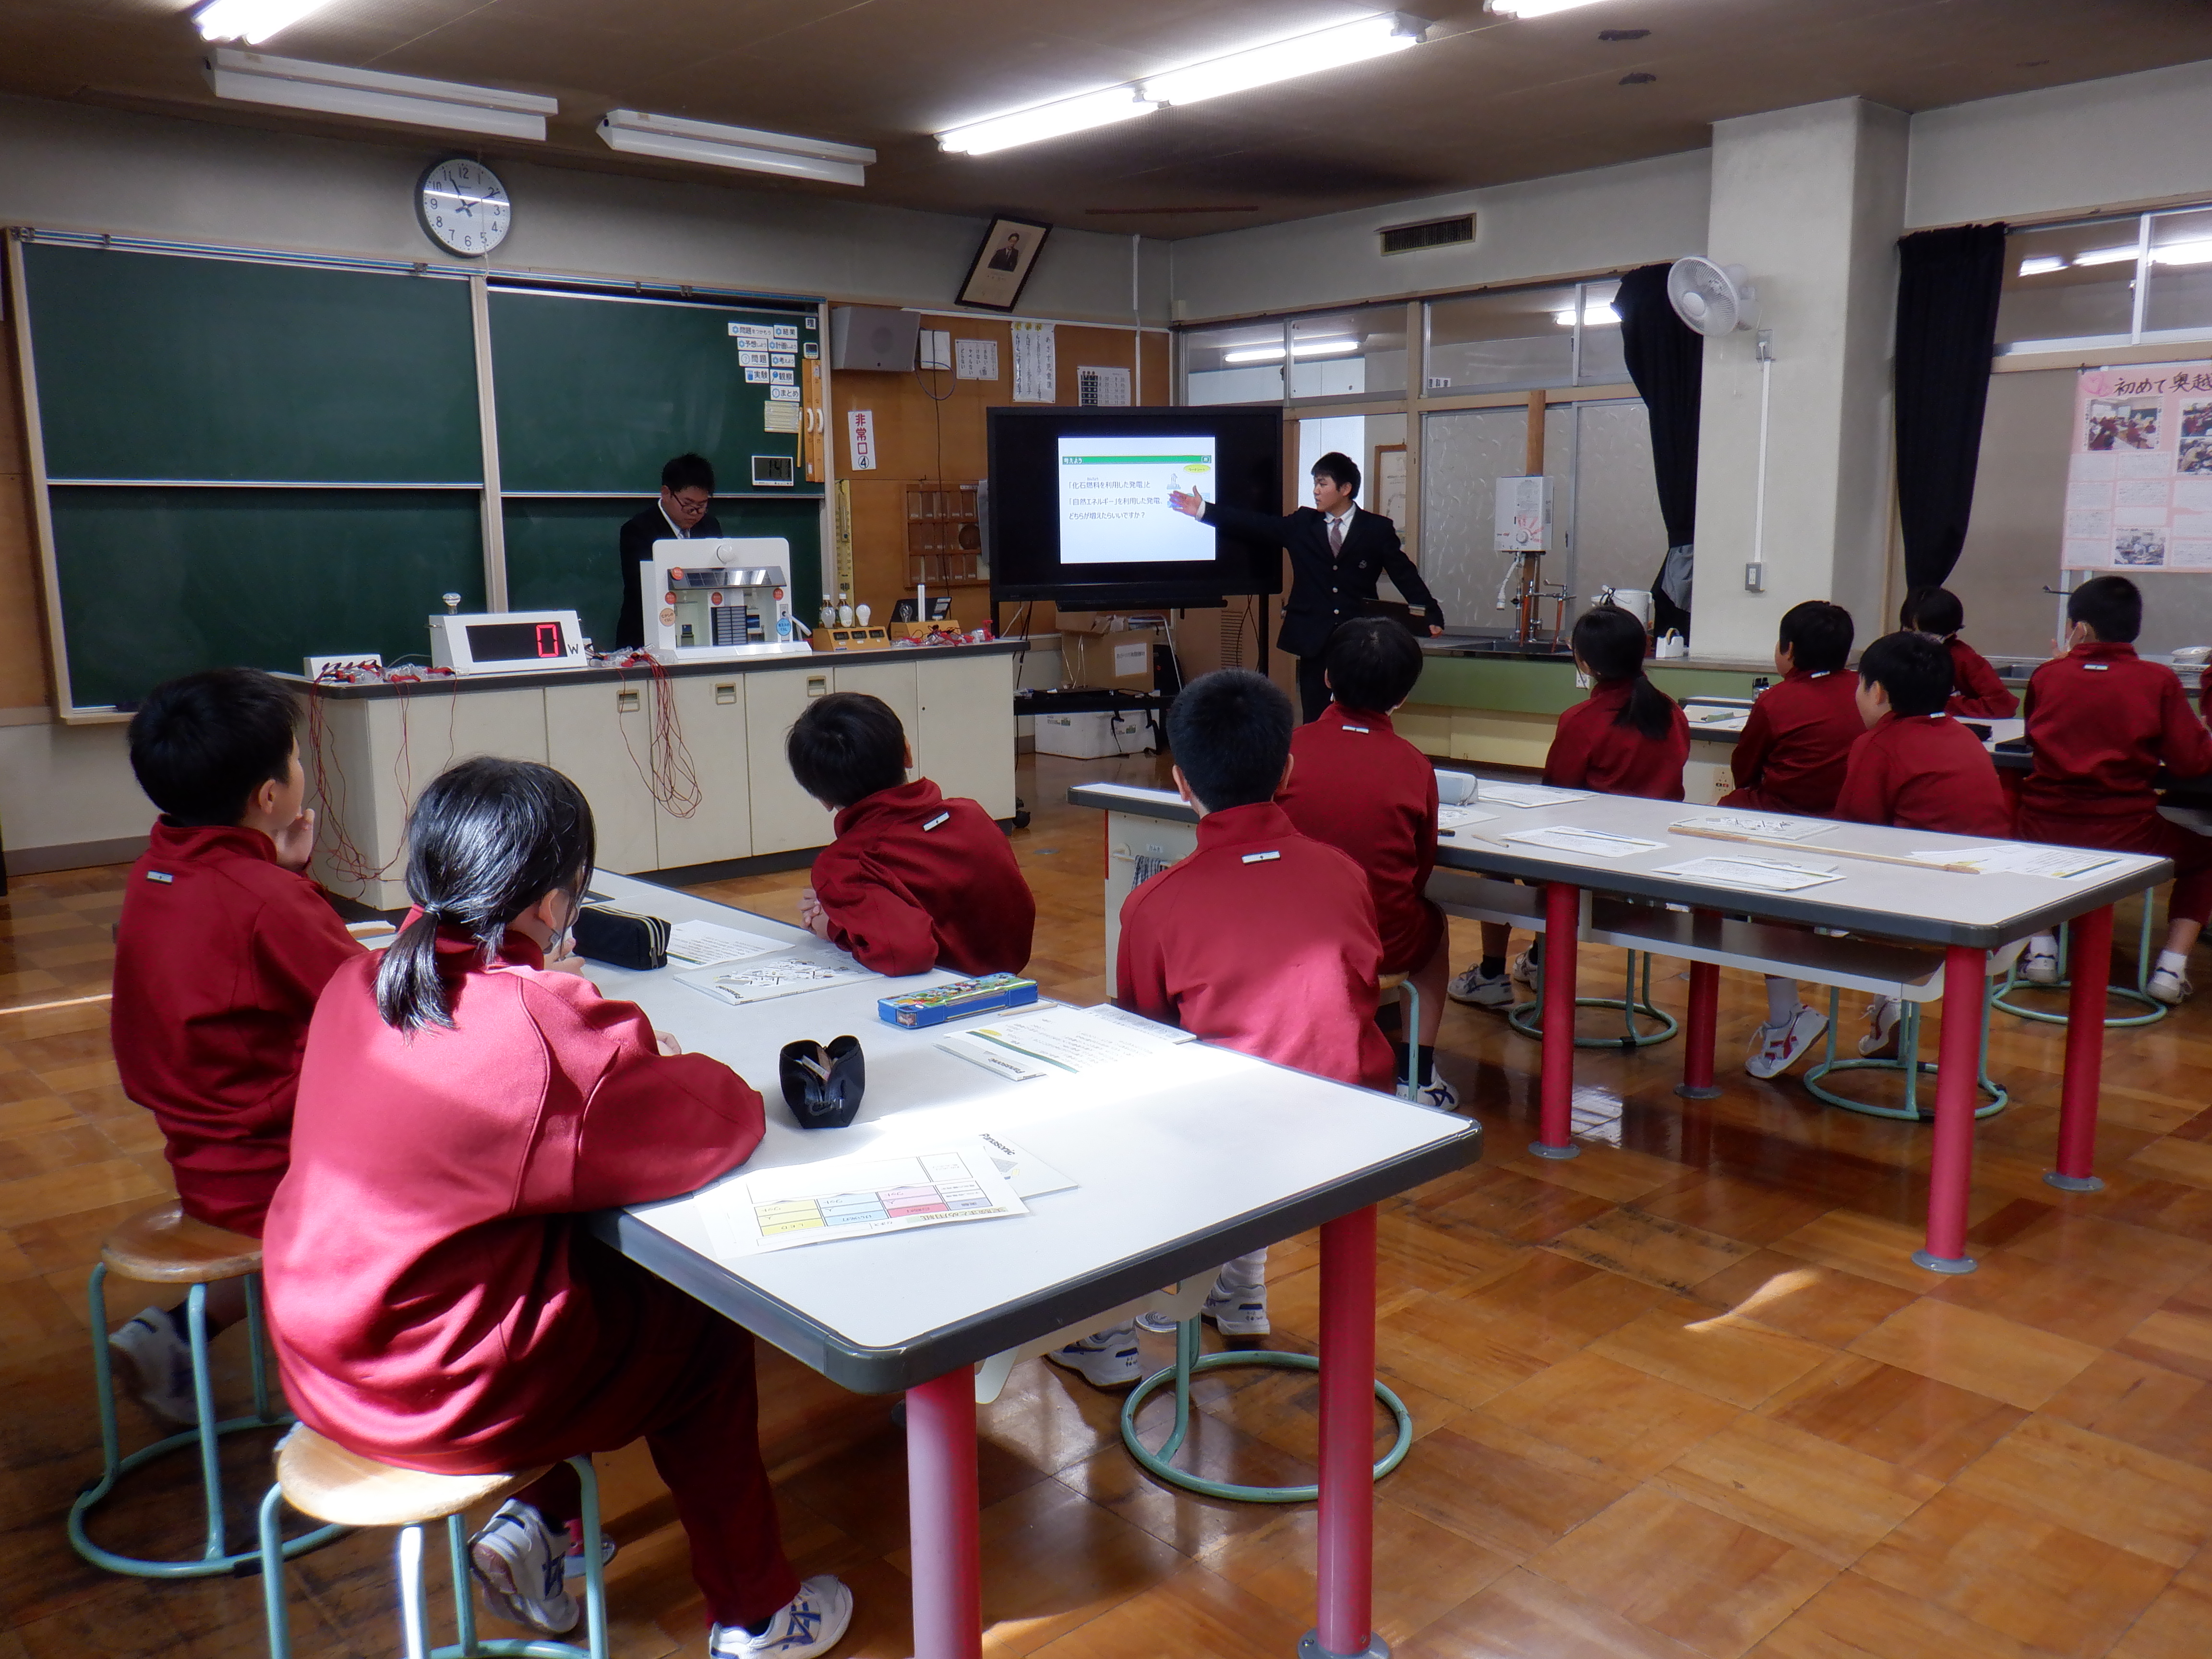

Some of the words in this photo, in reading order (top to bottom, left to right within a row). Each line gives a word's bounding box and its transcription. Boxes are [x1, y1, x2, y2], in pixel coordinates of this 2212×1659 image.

[444, 169, 452, 181] 11
[458, 167, 469, 180] 12
[478, 173, 481, 185] 1
[430, 198, 438, 209] 9
[493, 204, 500, 216] 3
[436, 216, 443, 228] 8
[492, 221, 498, 232] 4
[448, 229, 455, 240] 7
[480, 232, 487, 244] 5
[464, 235, 471, 247] 6
[807, 319, 814, 327] 理
[745, 340, 767, 348] 予想しよう
[751, 354, 767, 363] 問題
[754, 371, 768, 379] 実験
[779, 373, 793, 381] 観察
[536, 624, 559, 658] 0
[567, 643, 579, 655] W
[978, 1133, 1015, 1155] Panasonic
